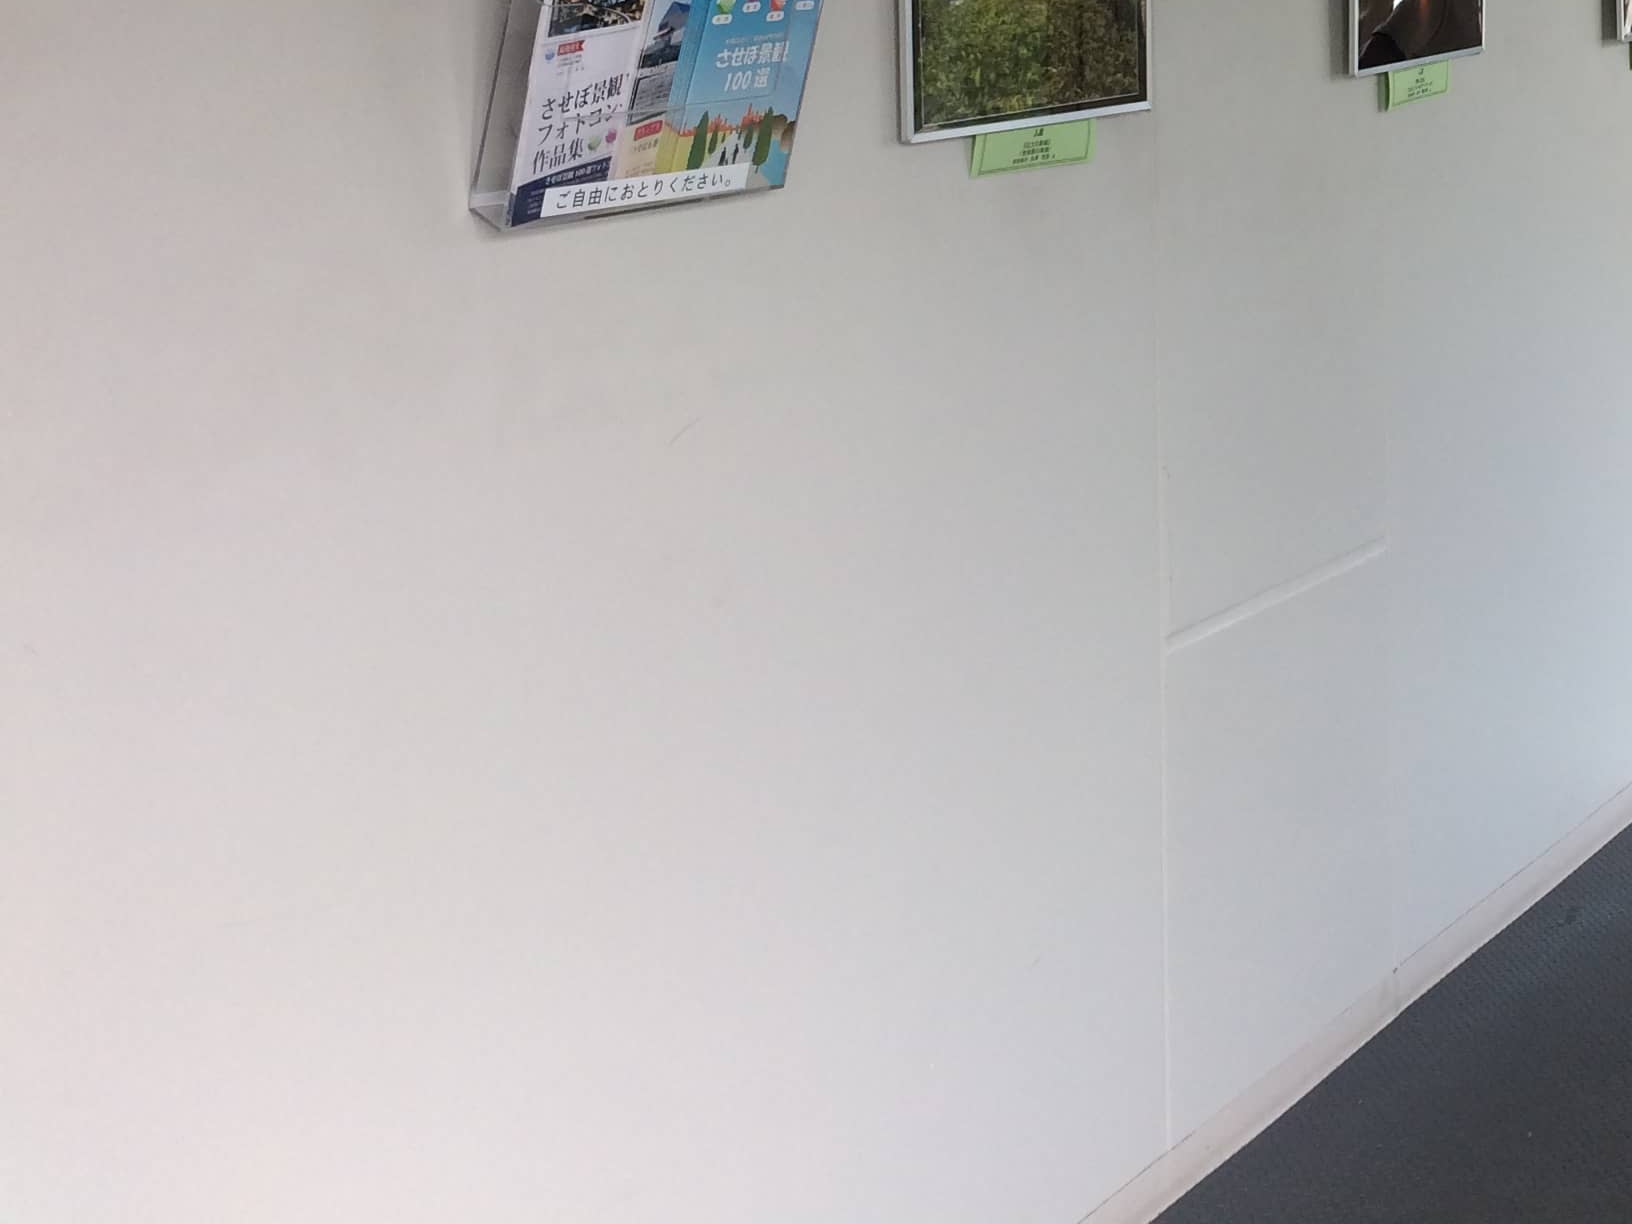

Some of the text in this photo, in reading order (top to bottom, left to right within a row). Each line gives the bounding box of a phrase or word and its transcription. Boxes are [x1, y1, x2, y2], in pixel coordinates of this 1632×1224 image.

[716, 41, 788, 68] させぼ景観
[541, 73, 624, 121] させぼ景観
[537, 103, 624, 146] フォトコン
[531, 137, 586, 175] 作品集
[556, 173, 733, 210] ご自由におとりください。
